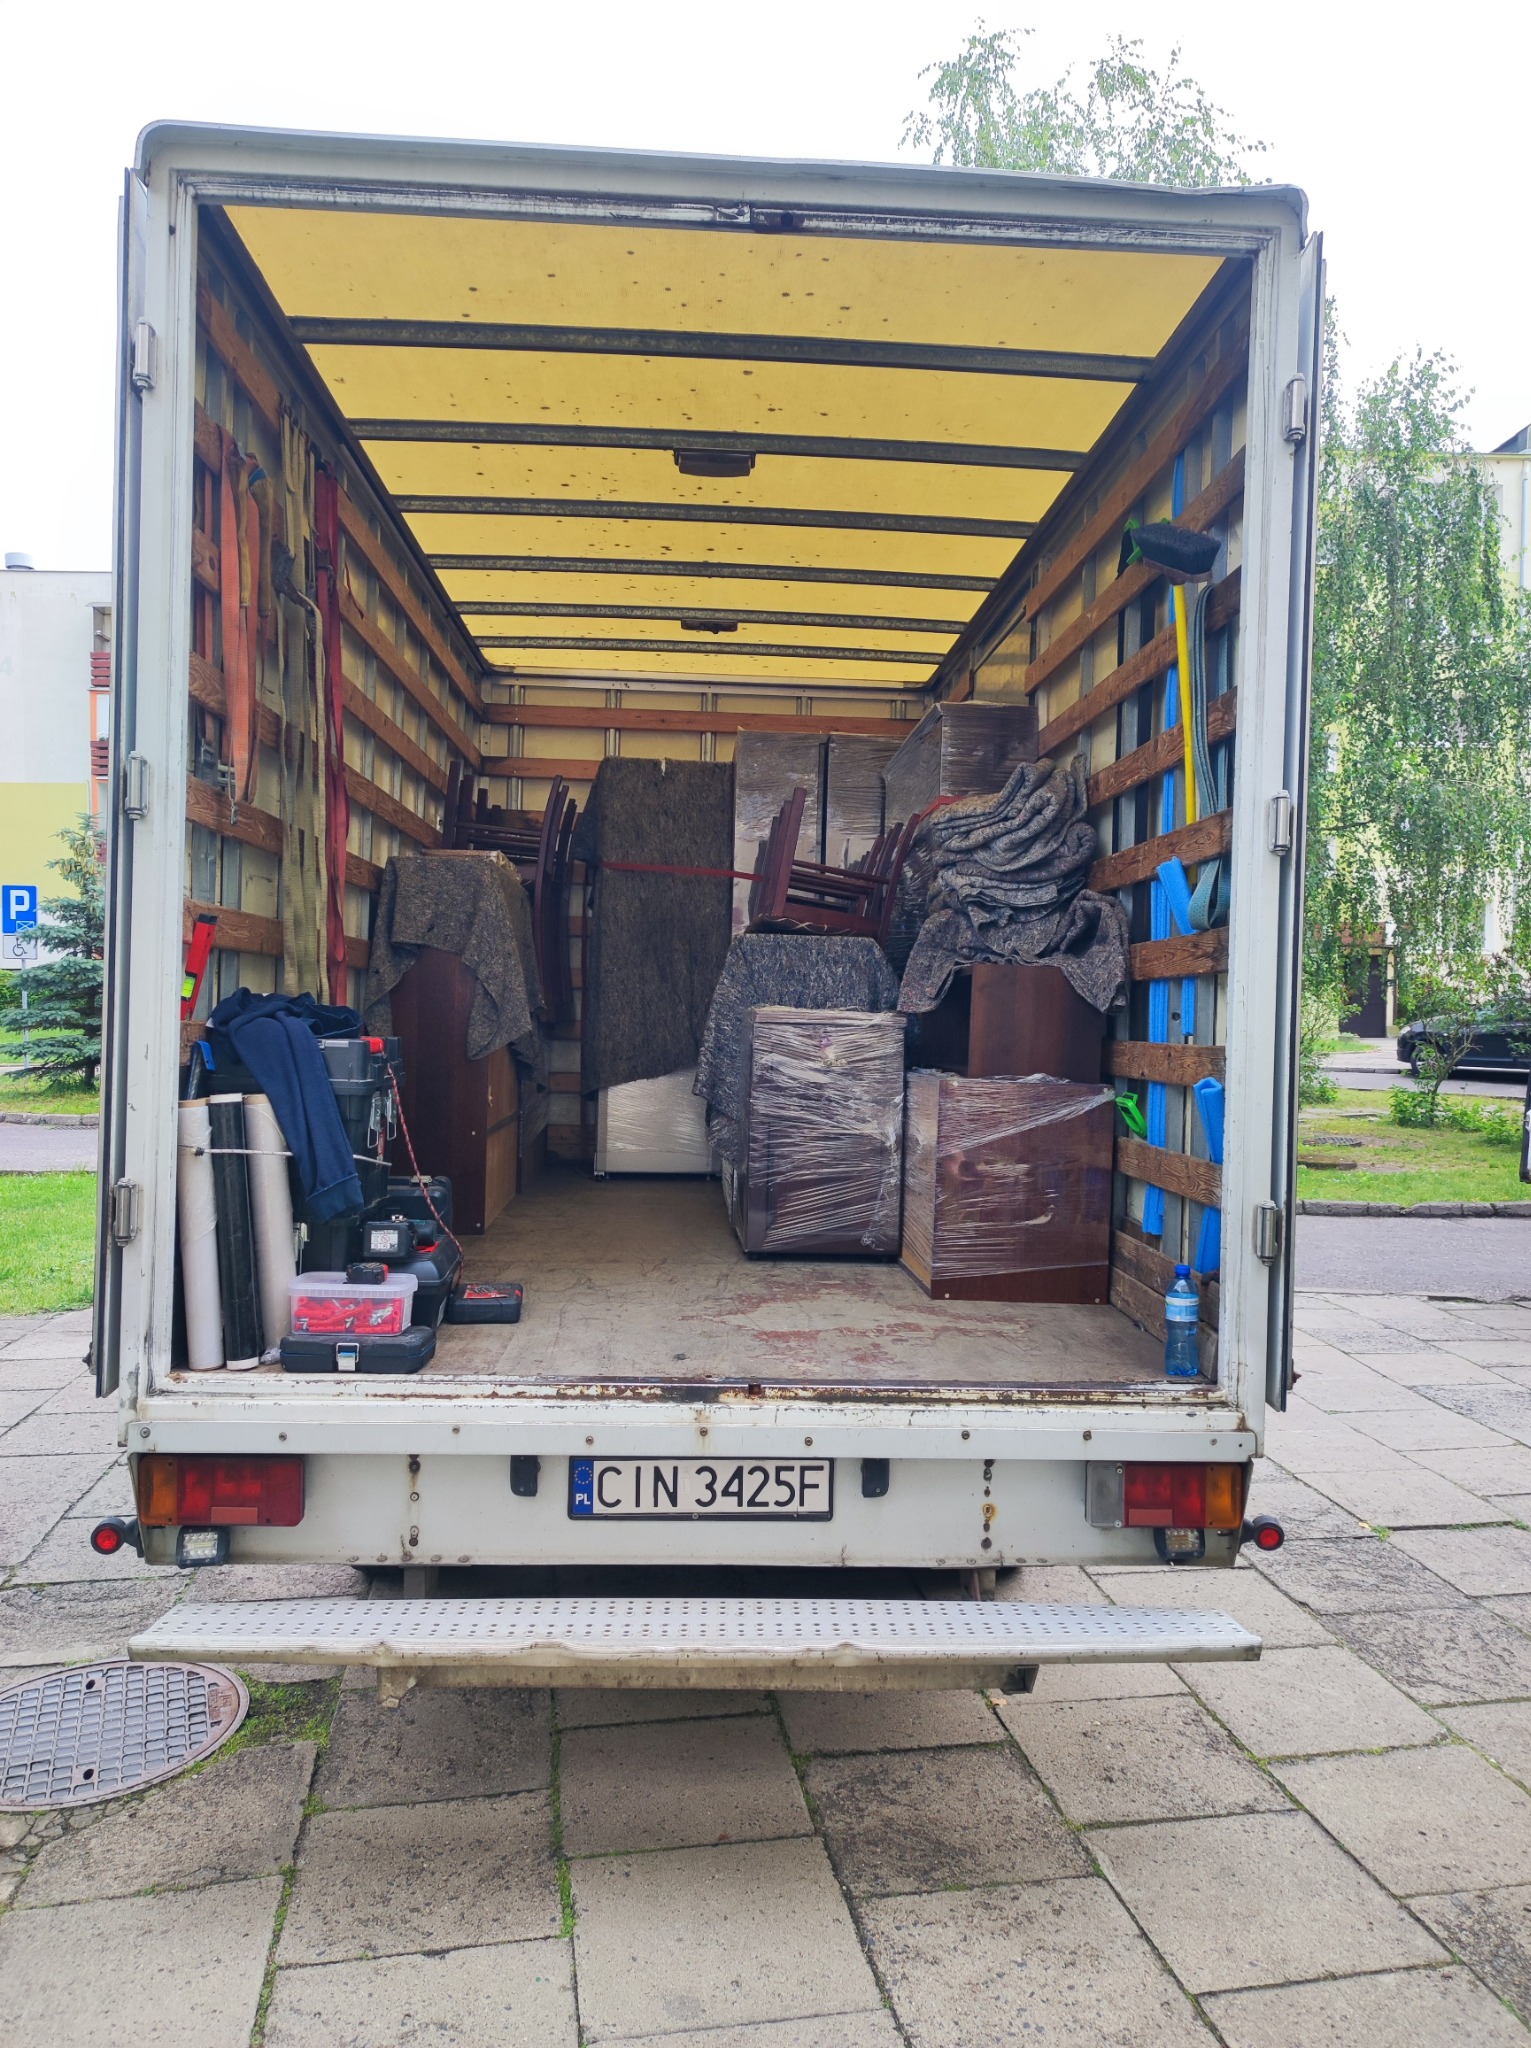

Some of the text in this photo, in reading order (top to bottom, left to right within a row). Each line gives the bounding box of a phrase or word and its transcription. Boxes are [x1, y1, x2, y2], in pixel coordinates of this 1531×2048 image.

[9, 889, 30, 920] P
[575, 1493, 591, 1505] PL
[597, 1465, 825, 1508] CIN 3425F
